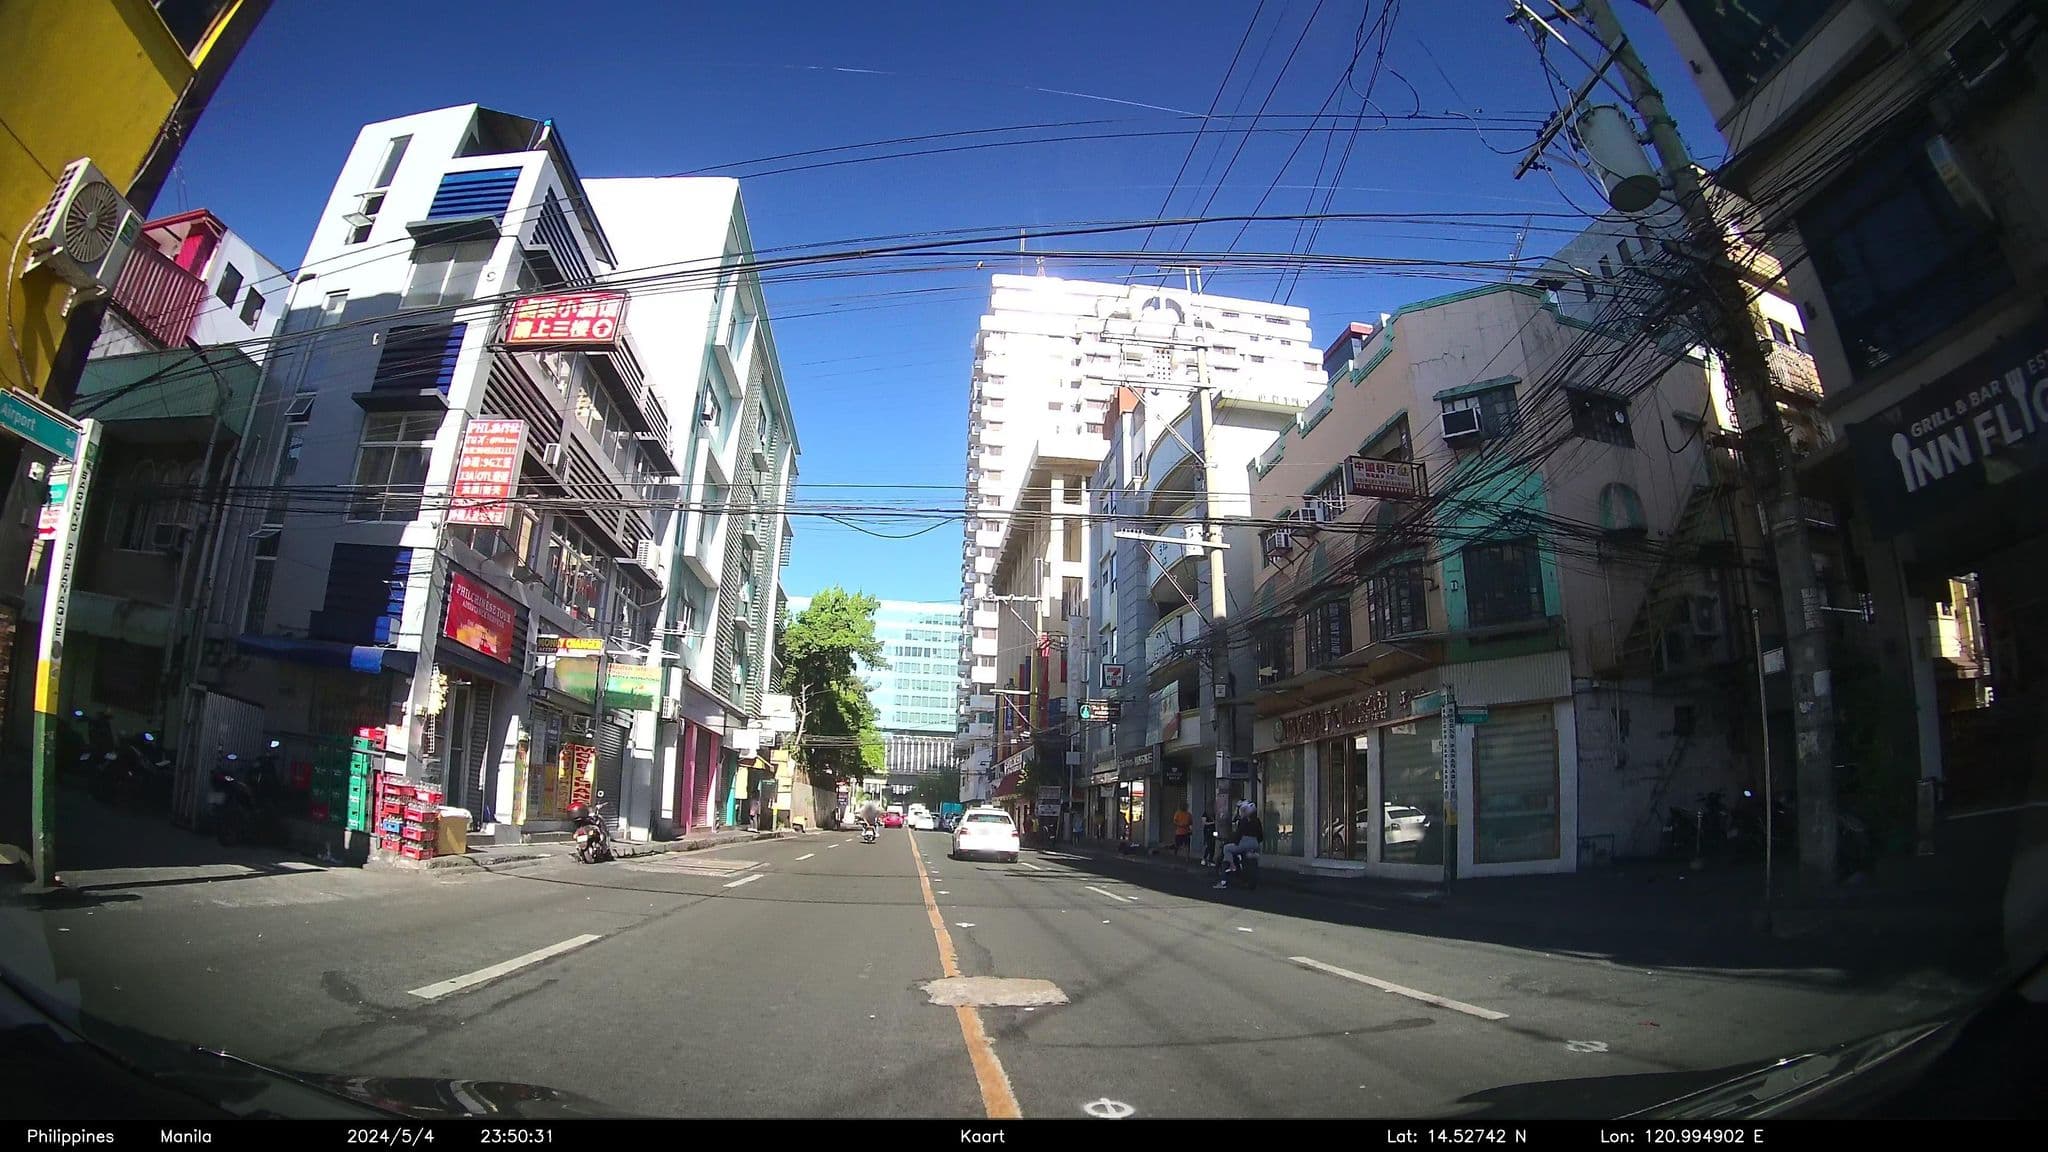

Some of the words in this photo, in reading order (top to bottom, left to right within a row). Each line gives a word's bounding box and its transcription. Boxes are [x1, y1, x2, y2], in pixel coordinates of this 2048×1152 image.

[1, 402, 37, 432] Airport
[1910, 406, 1956, 438] GRILL
[1954, 399, 1968, 415] &
[1968, 378, 2003, 408] BAR
[538, 638, 564, 649] MONEY
